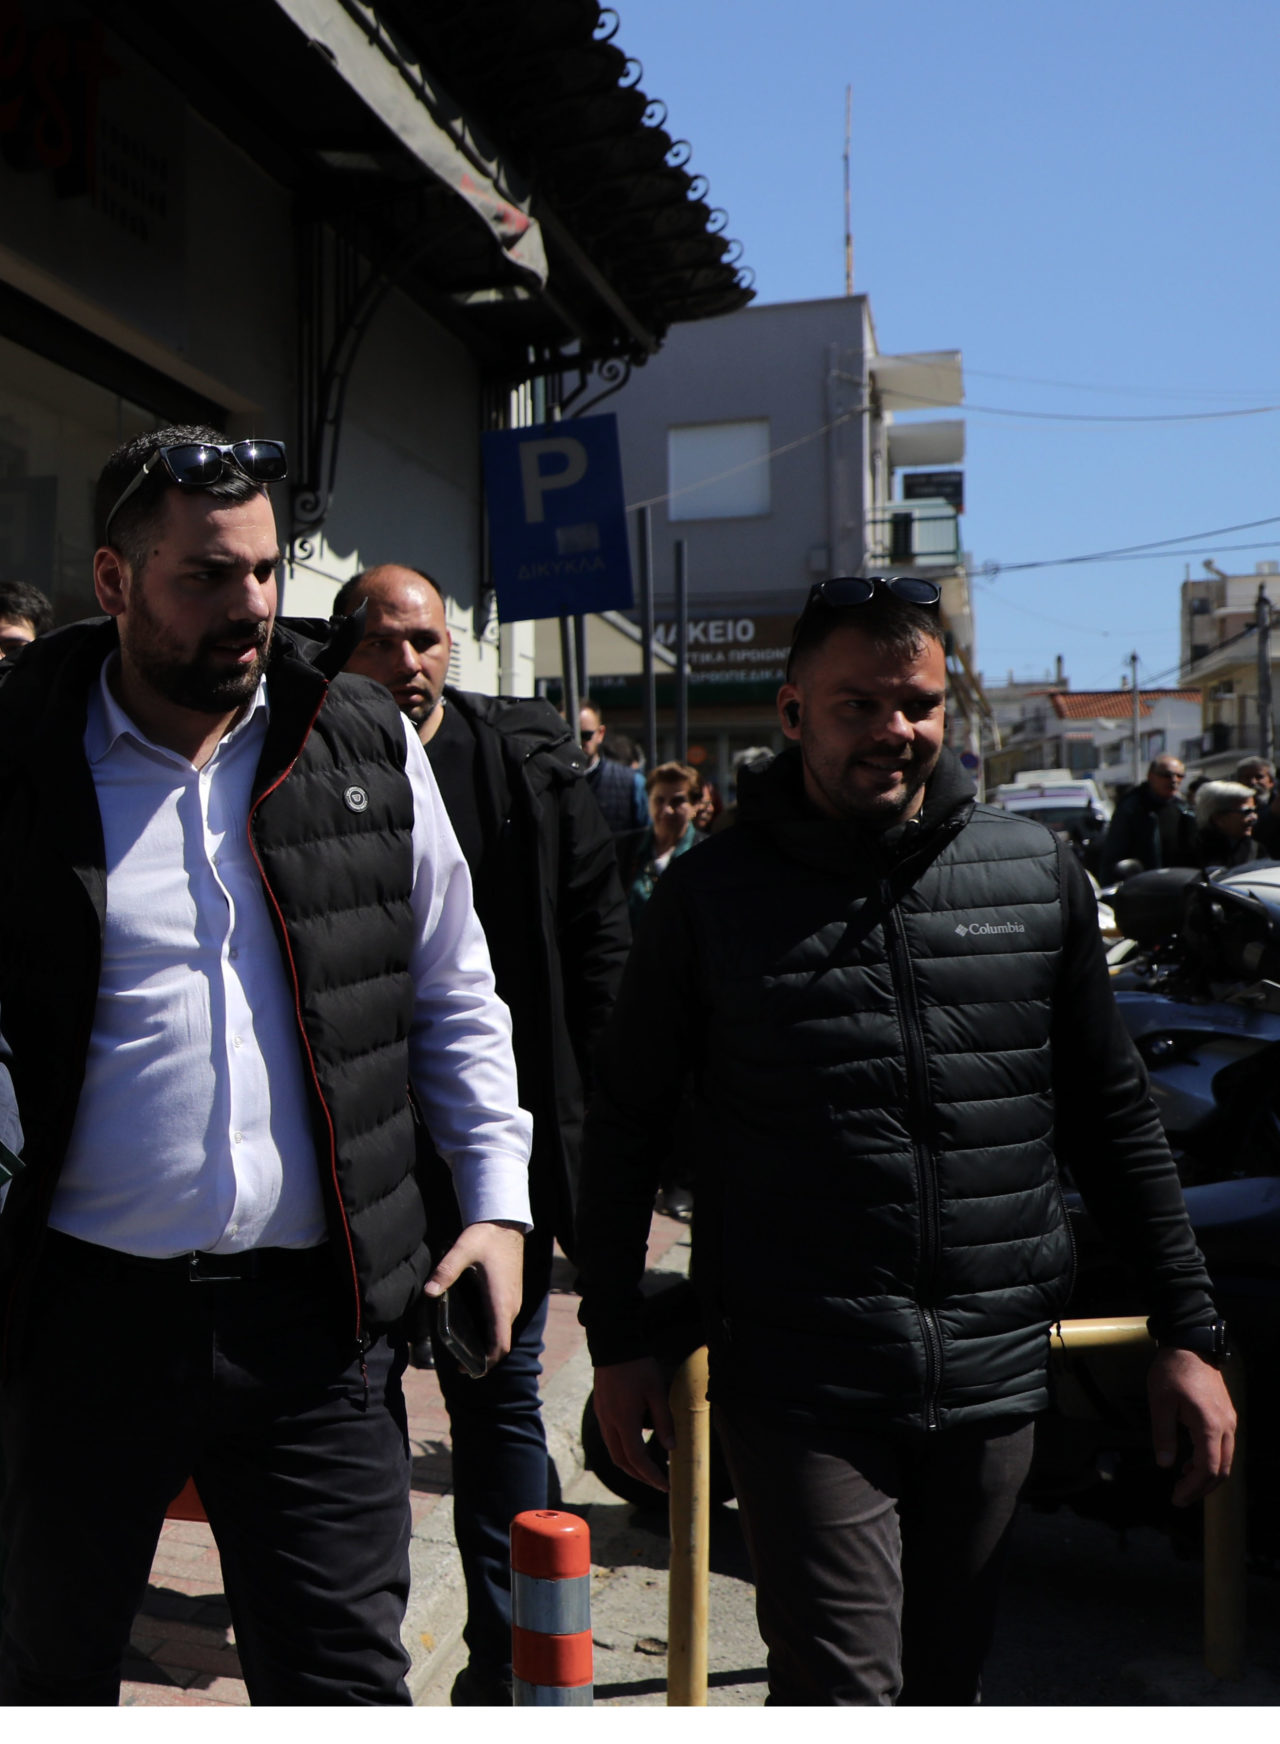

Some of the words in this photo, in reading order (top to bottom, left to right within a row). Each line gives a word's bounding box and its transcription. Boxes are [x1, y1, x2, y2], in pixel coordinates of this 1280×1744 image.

[519, 436, 589, 525] P
[517, 554, 607, 581] ΔΙΚΥΚΛΑ
[969, 922, 1025, 935] Columbia
